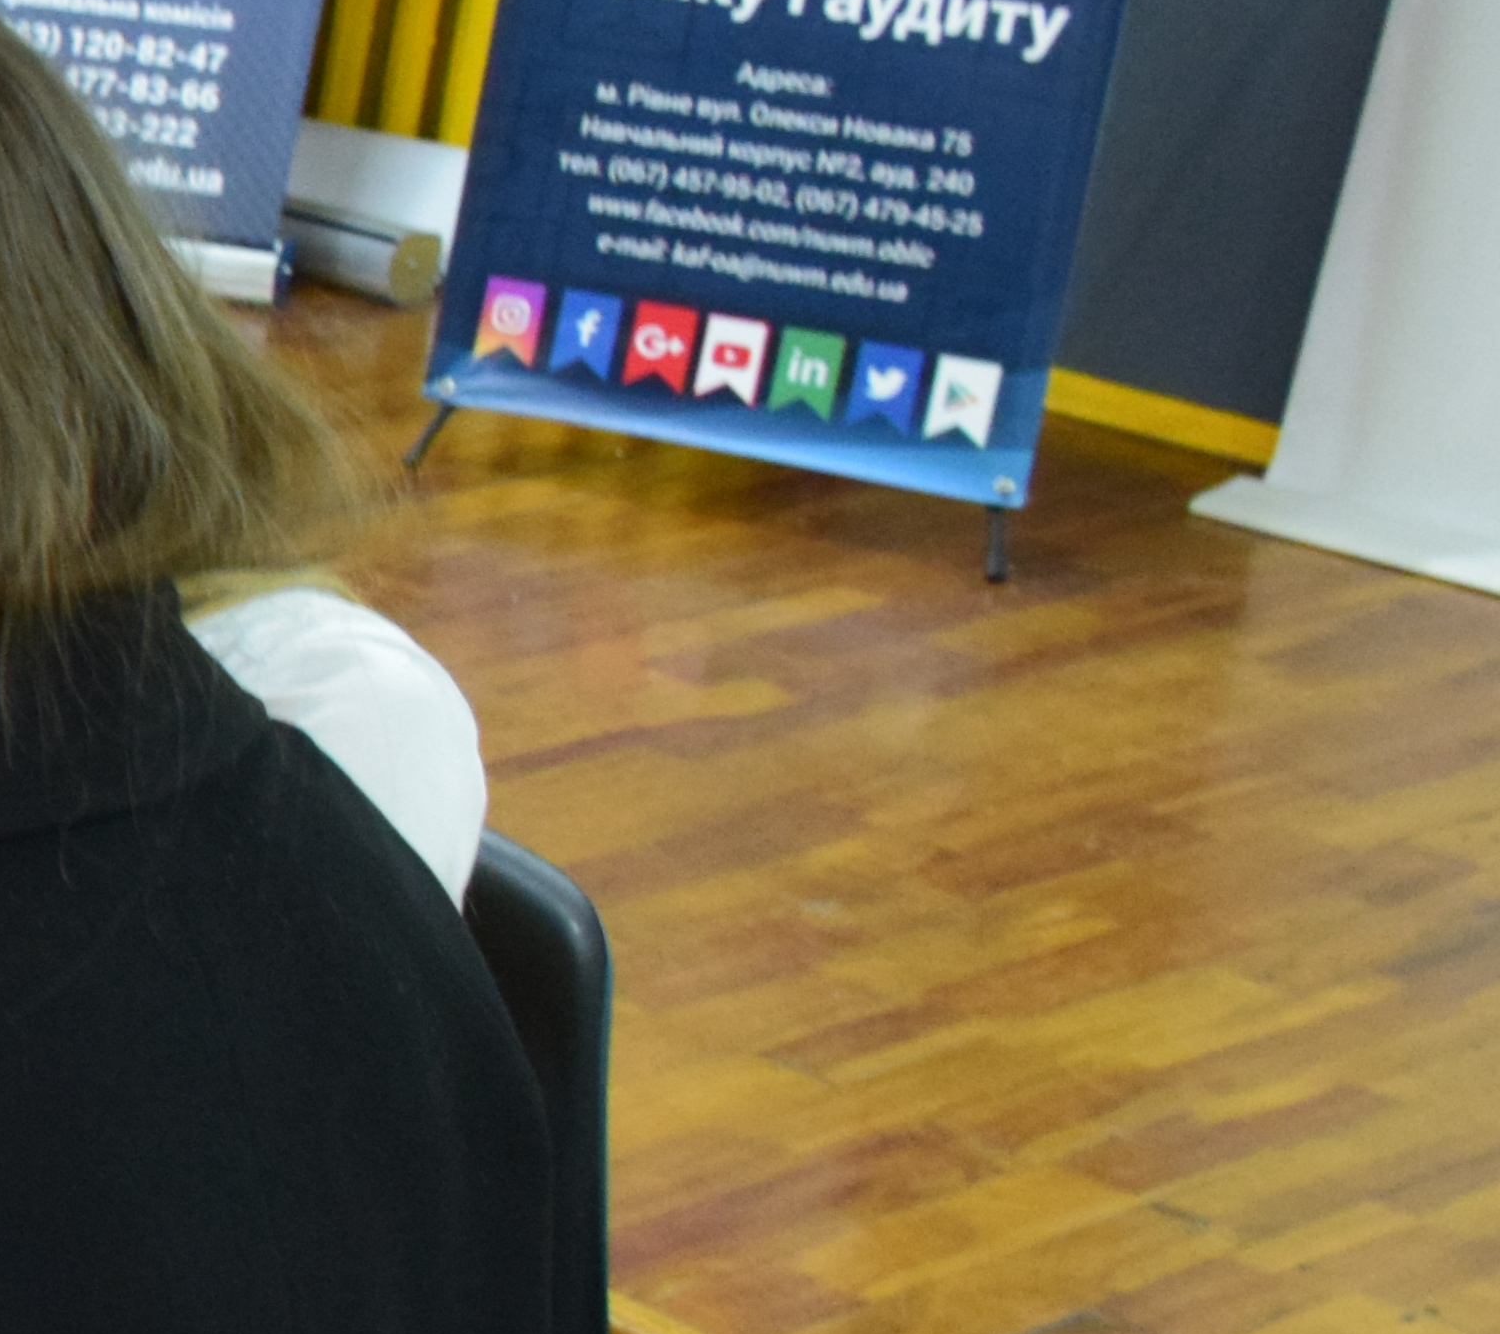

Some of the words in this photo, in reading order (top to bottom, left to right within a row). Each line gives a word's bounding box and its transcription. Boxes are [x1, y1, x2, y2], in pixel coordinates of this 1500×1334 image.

[69, 25, 230, 74] 120-82-47
[735, 59, 834, 99] Адреса:
[925, 165, 976, 198] 240
[787, 345, 830, 388] in
